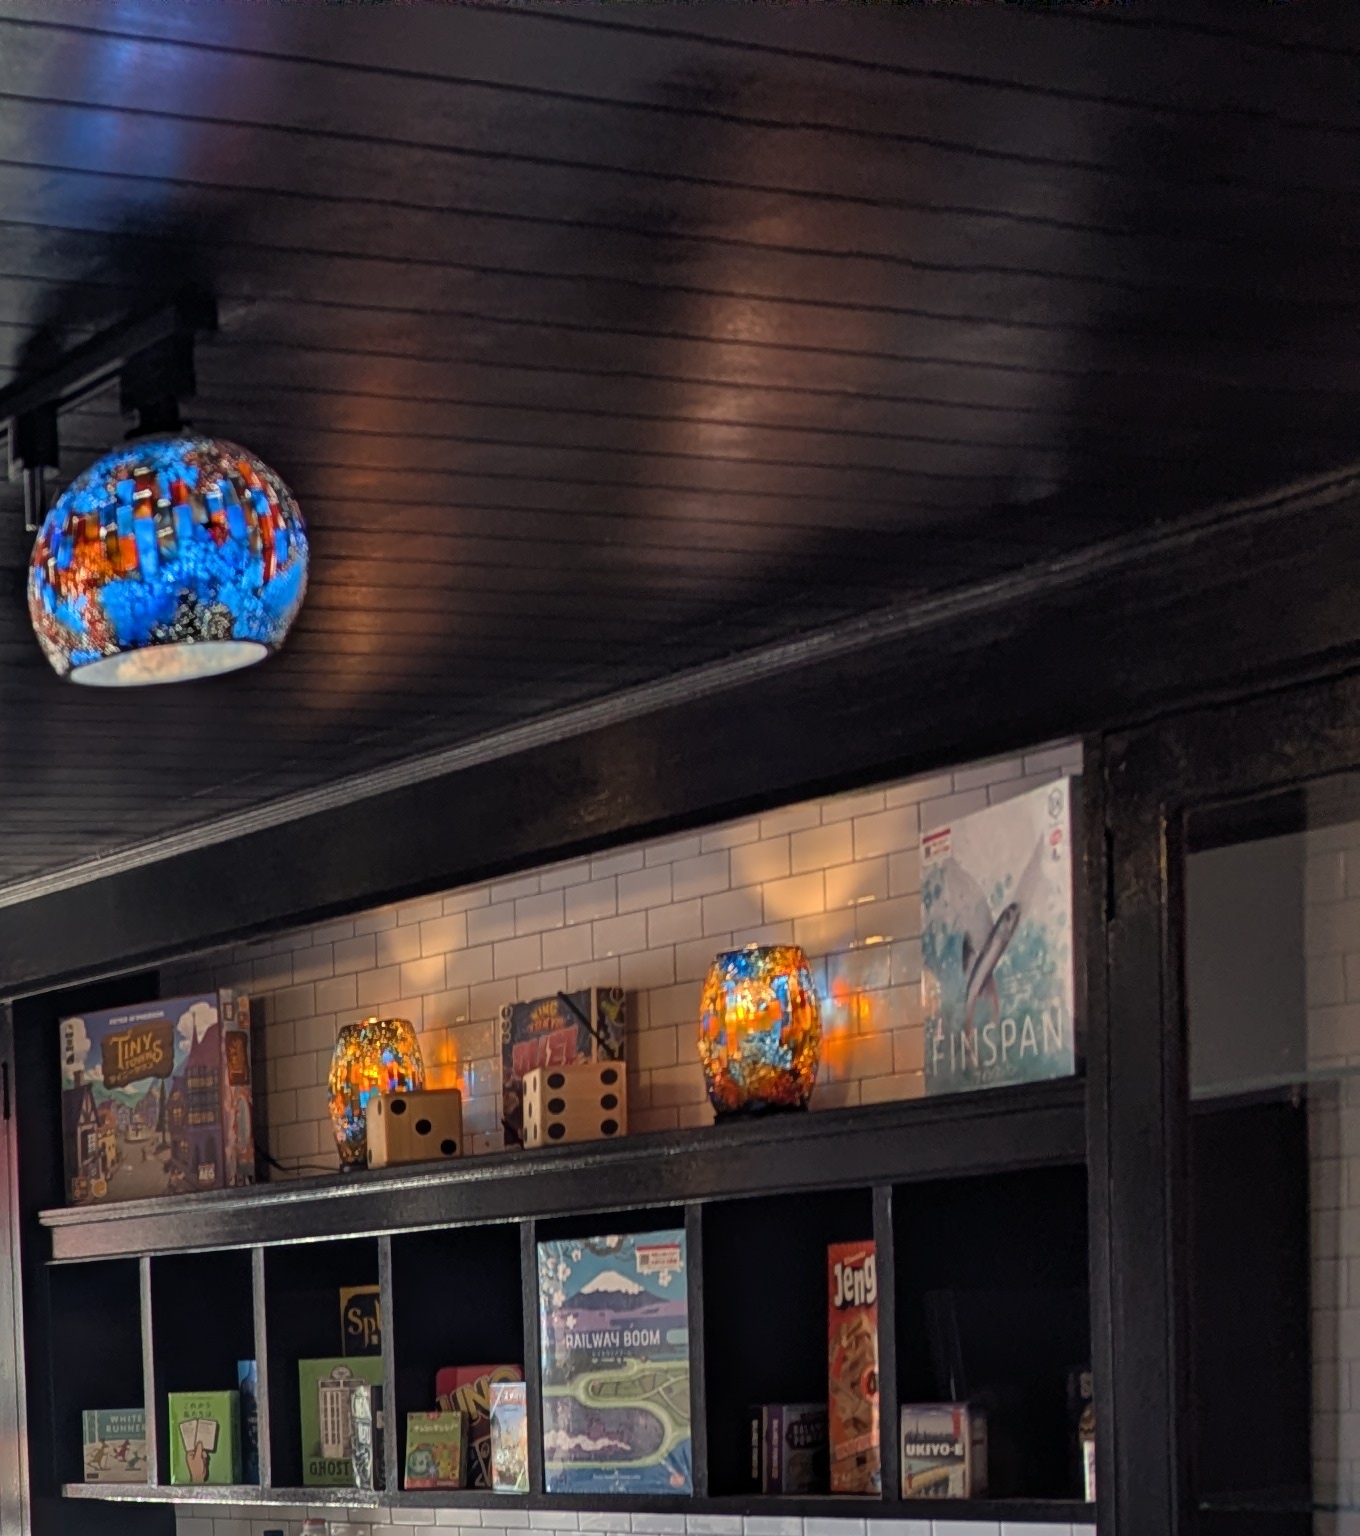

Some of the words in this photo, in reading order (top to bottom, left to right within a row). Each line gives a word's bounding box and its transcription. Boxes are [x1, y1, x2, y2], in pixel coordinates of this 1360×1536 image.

[109, 1029, 153, 1070] TINY
[932, 1007, 1064, 1077] FINSPAN
[834, 1254, 877, 1307] Jeng
[347, 1299, 382, 1348] Spl
[565, 1331, 620, 1349] RAILWAY
[623, 1328, 661, 1347] BOOM
[110, 1414, 142, 1424] WHITE
[906, 1443, 964, 1457] UKIYO-E
[309, 1461, 351, 1477] GHOST
